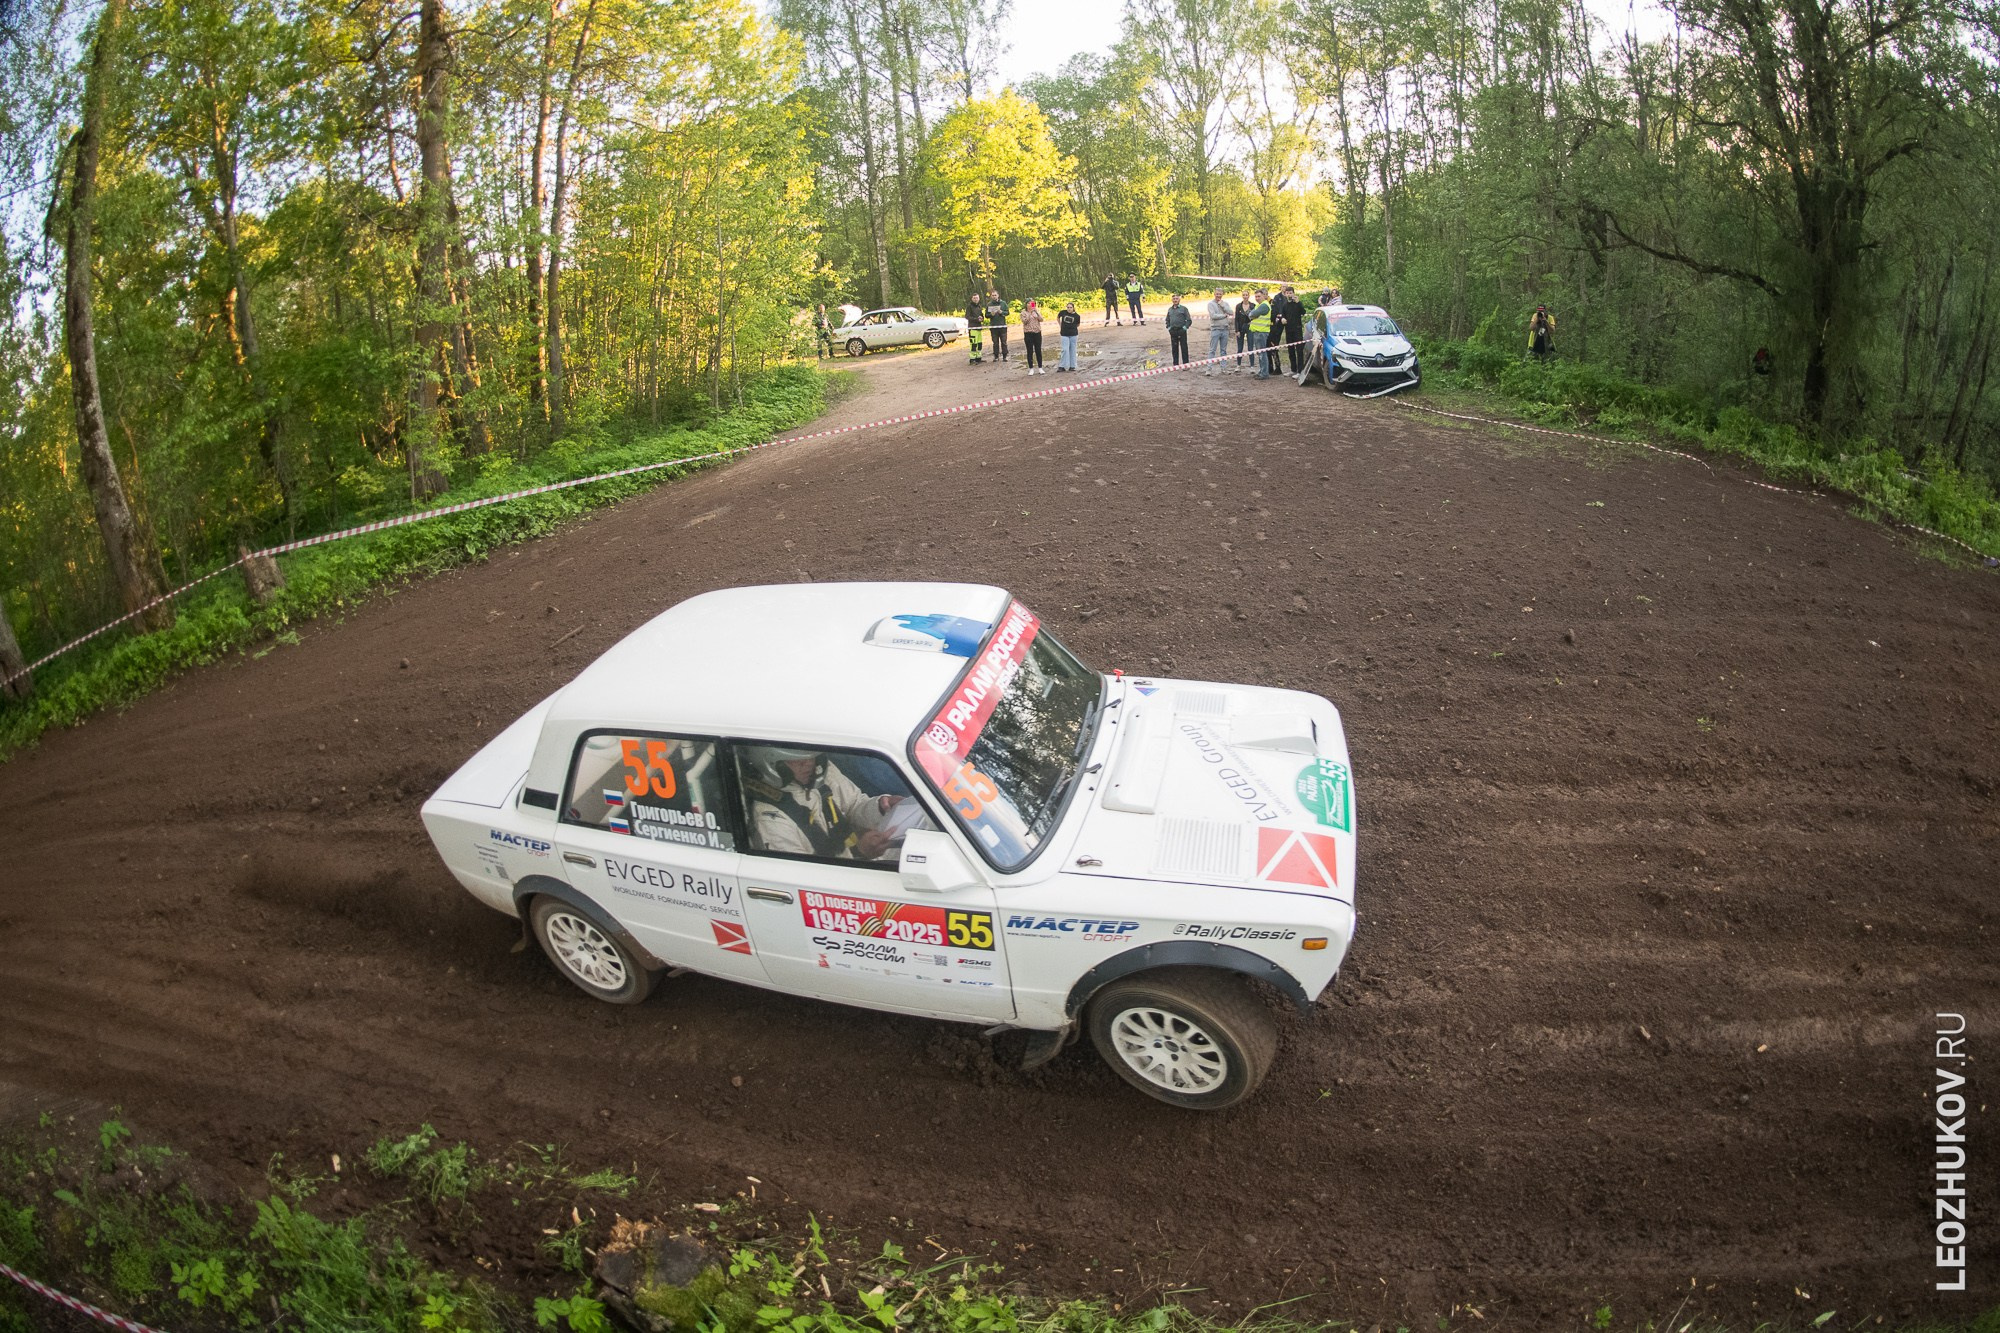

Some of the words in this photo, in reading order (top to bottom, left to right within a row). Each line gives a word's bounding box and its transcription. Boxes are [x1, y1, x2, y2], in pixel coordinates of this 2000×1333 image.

[947, 664, 998, 731] РАЛЛИ
[986, 614, 1027, 667] РОССИИ
[1180, 724, 1224, 763] Group
[620, 739, 676, 799] 55
[1320, 759, 1347, 781] 55
[943, 761, 999, 820] 55
[1218, 768, 1278, 821] EVGED
[630, 801, 705, 828] Григорьев
[705, 811, 721, 831] О.
[490, 829, 551, 852] МАСТЕР
[634, 819, 706, 846] Сергиенко
[708, 831, 725, 849] И.
[604, 858, 675, 889] EVGED
[683, 873, 733, 905] Rally
[612, 884, 656, 901] WORLDWIDE
[709, 905, 740, 917] SERVICE
[805, 892, 825, 908] 80
[826, 896, 877, 914] ПОБЕДА!
[809, 909, 862, 935] 1945
[883, 919, 943, 946] 2025
[948, 912, 993, 949] 55
[1006, 915, 1141, 935] МАСТЕР
[1083, 934, 1134, 943] СПОРТ
[1173, 923, 1296, 941] @RallyClassic
[842, 947, 905, 964] РОССИИ
[843, 939, 897, 954] РАЛЛИ
